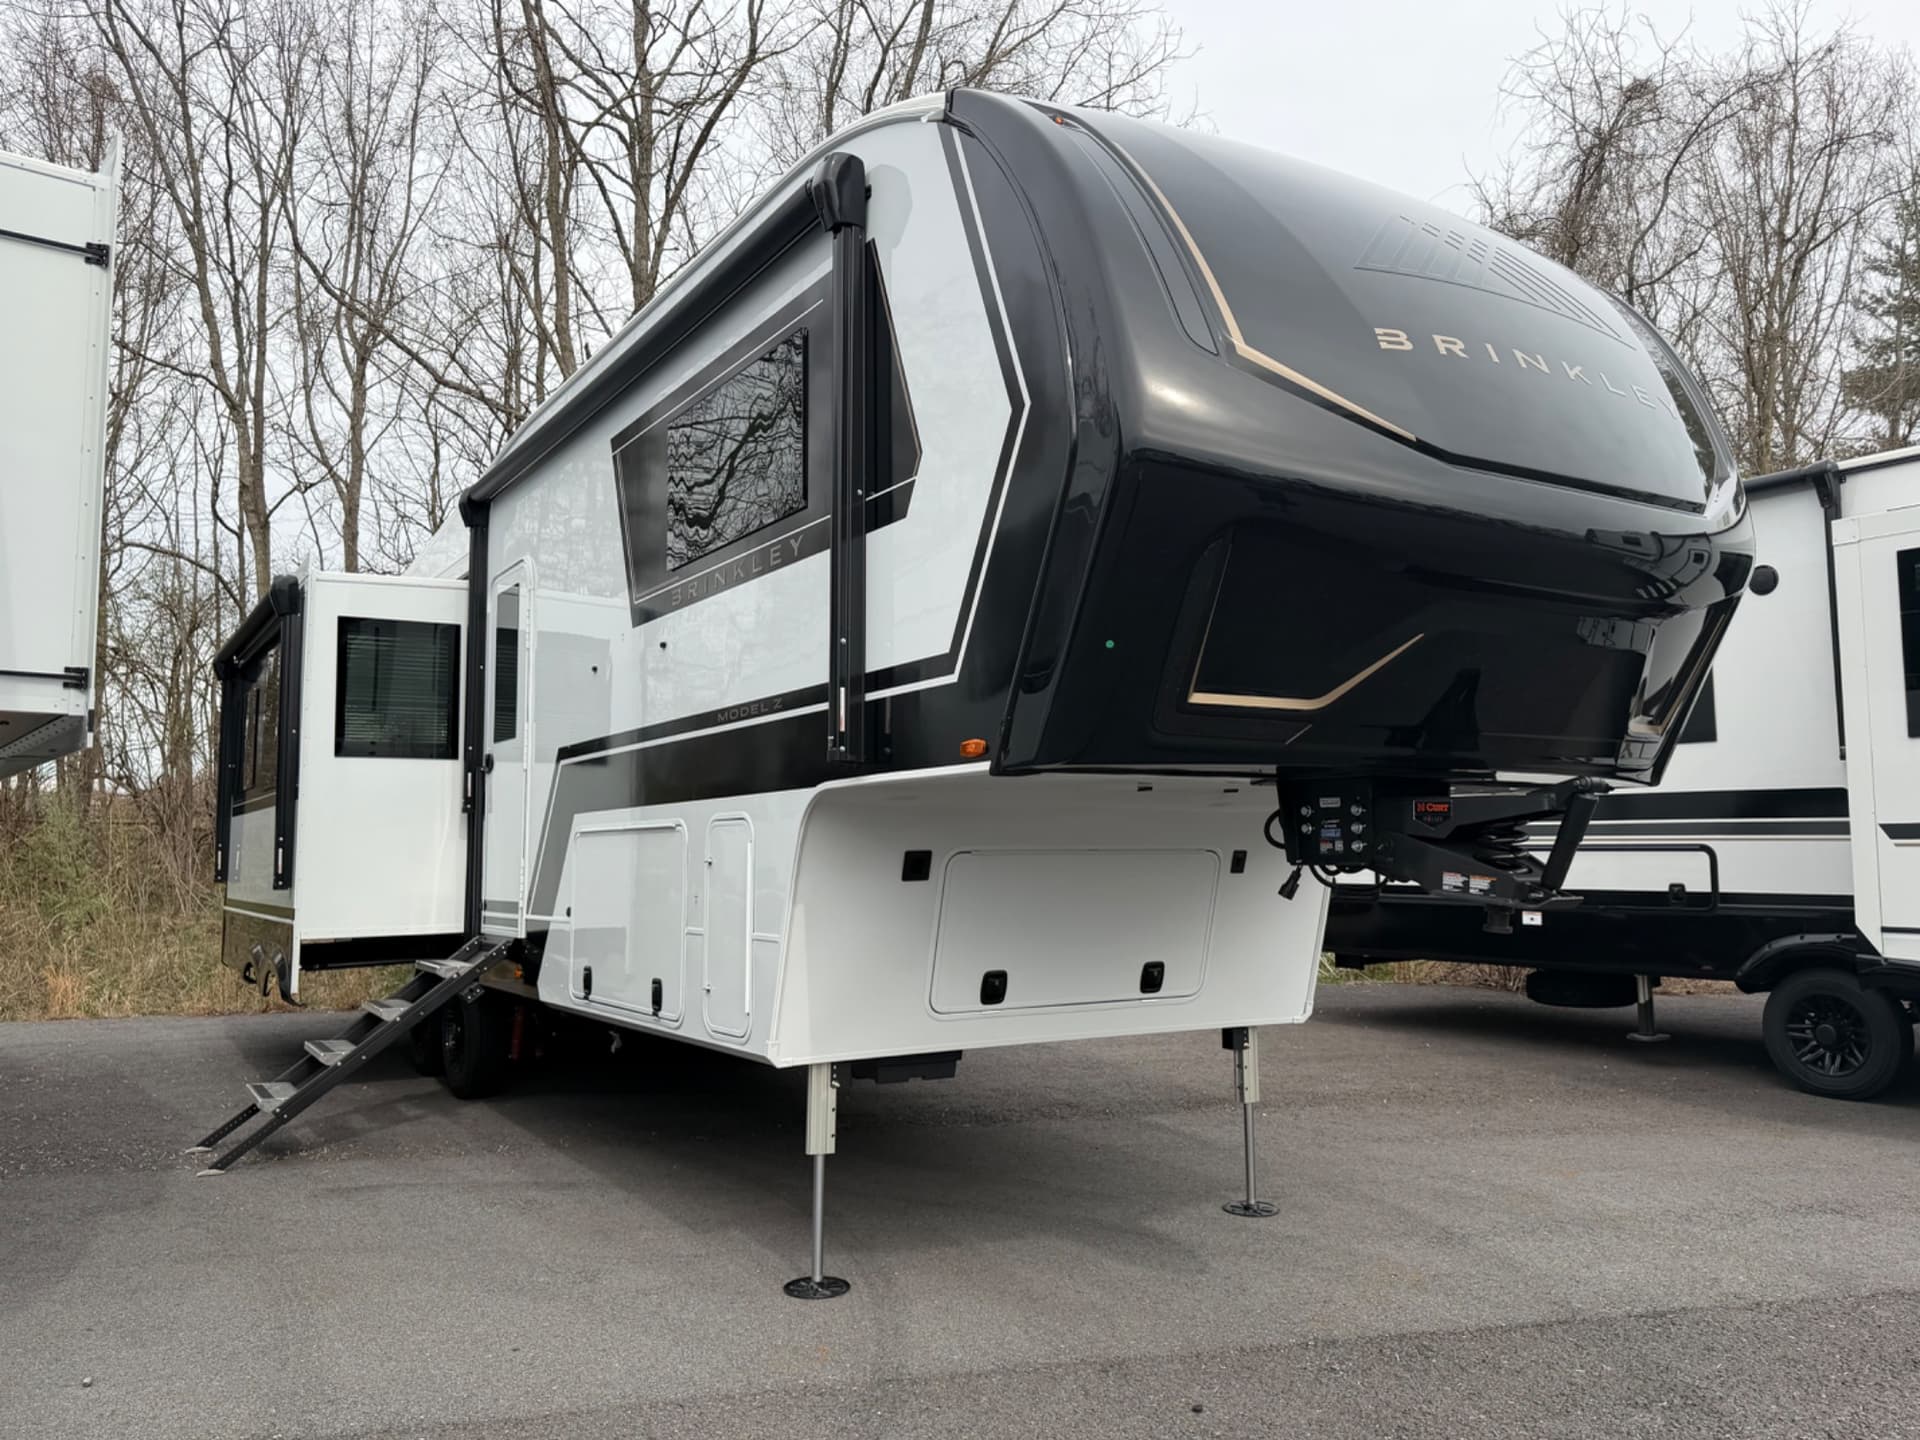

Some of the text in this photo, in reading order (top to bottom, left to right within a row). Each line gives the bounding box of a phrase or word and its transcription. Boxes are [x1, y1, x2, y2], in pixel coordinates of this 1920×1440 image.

[671, 534, 804, 606] BRINKLEY
[718, 697, 783, 721] MODEL Z
